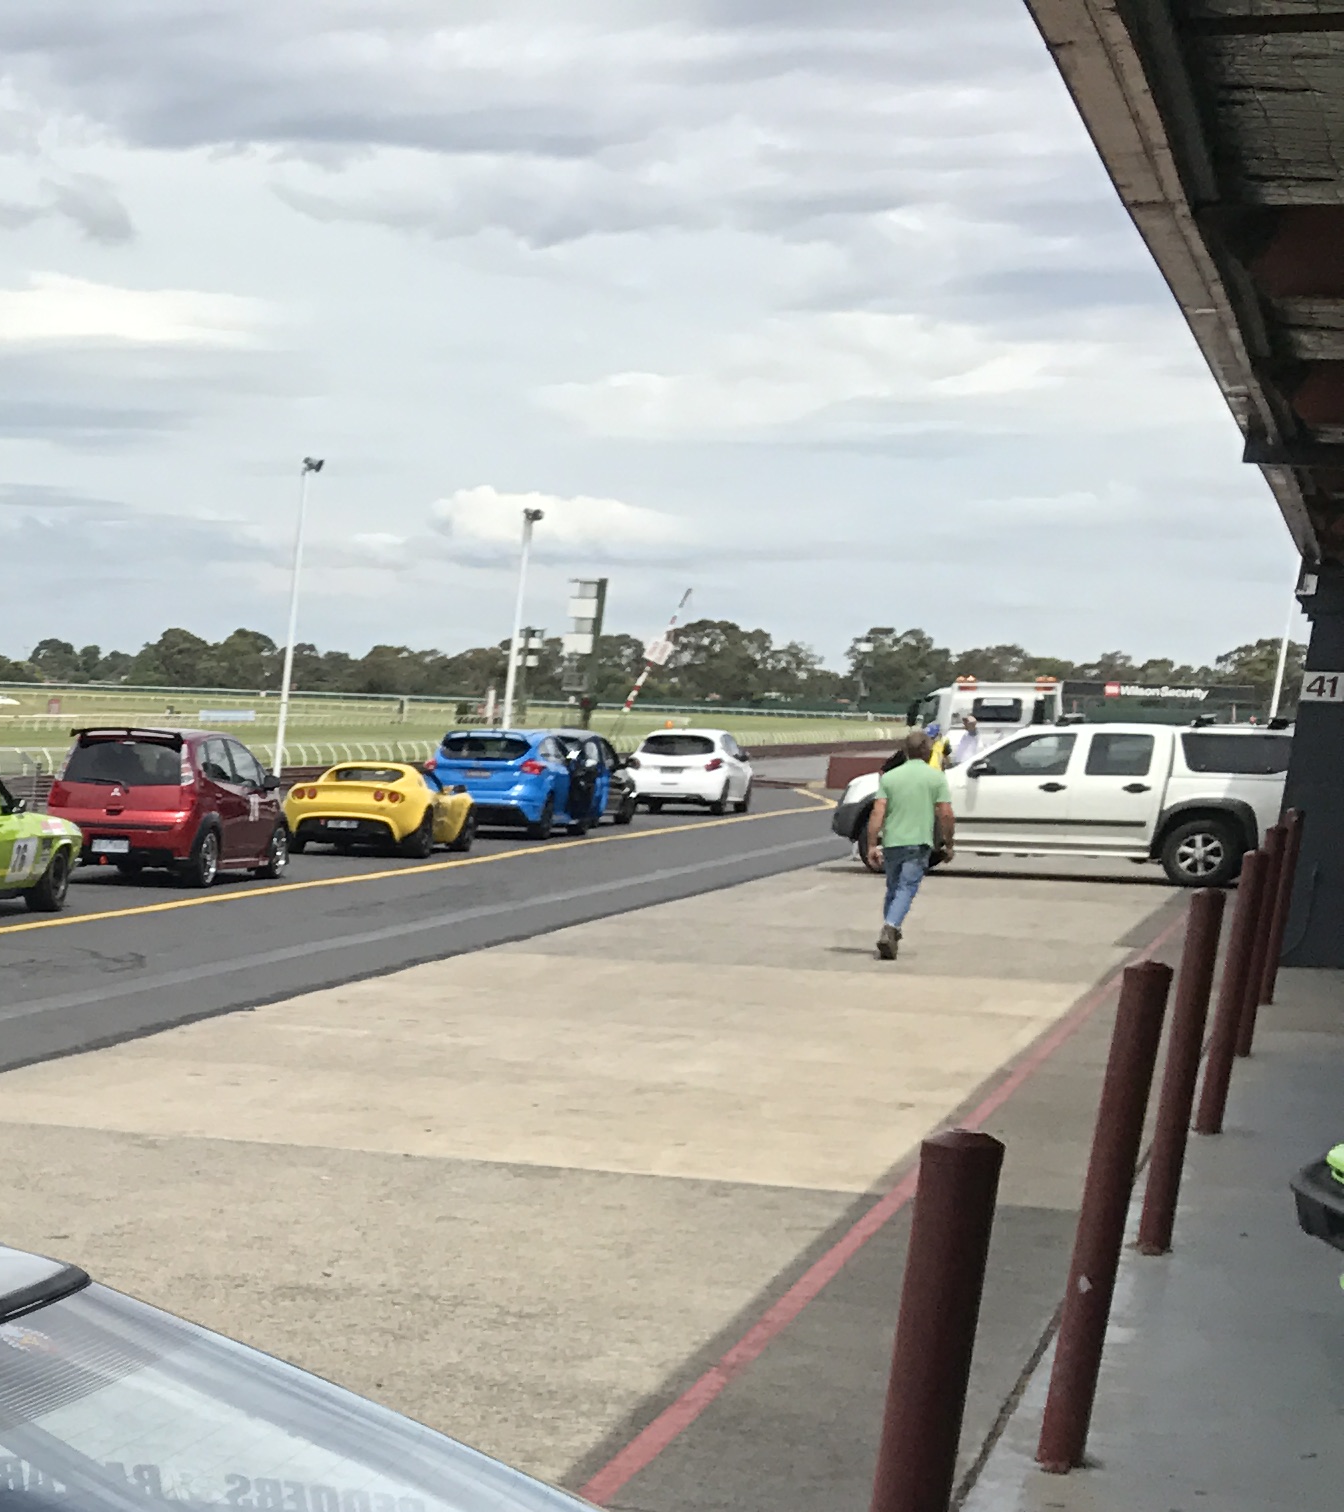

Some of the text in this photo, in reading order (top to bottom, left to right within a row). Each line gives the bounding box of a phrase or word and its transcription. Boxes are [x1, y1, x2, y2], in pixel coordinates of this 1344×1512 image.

[1120, 685, 1210, 702] Wilson Security
[1306, 675, 1339, 698] 41
